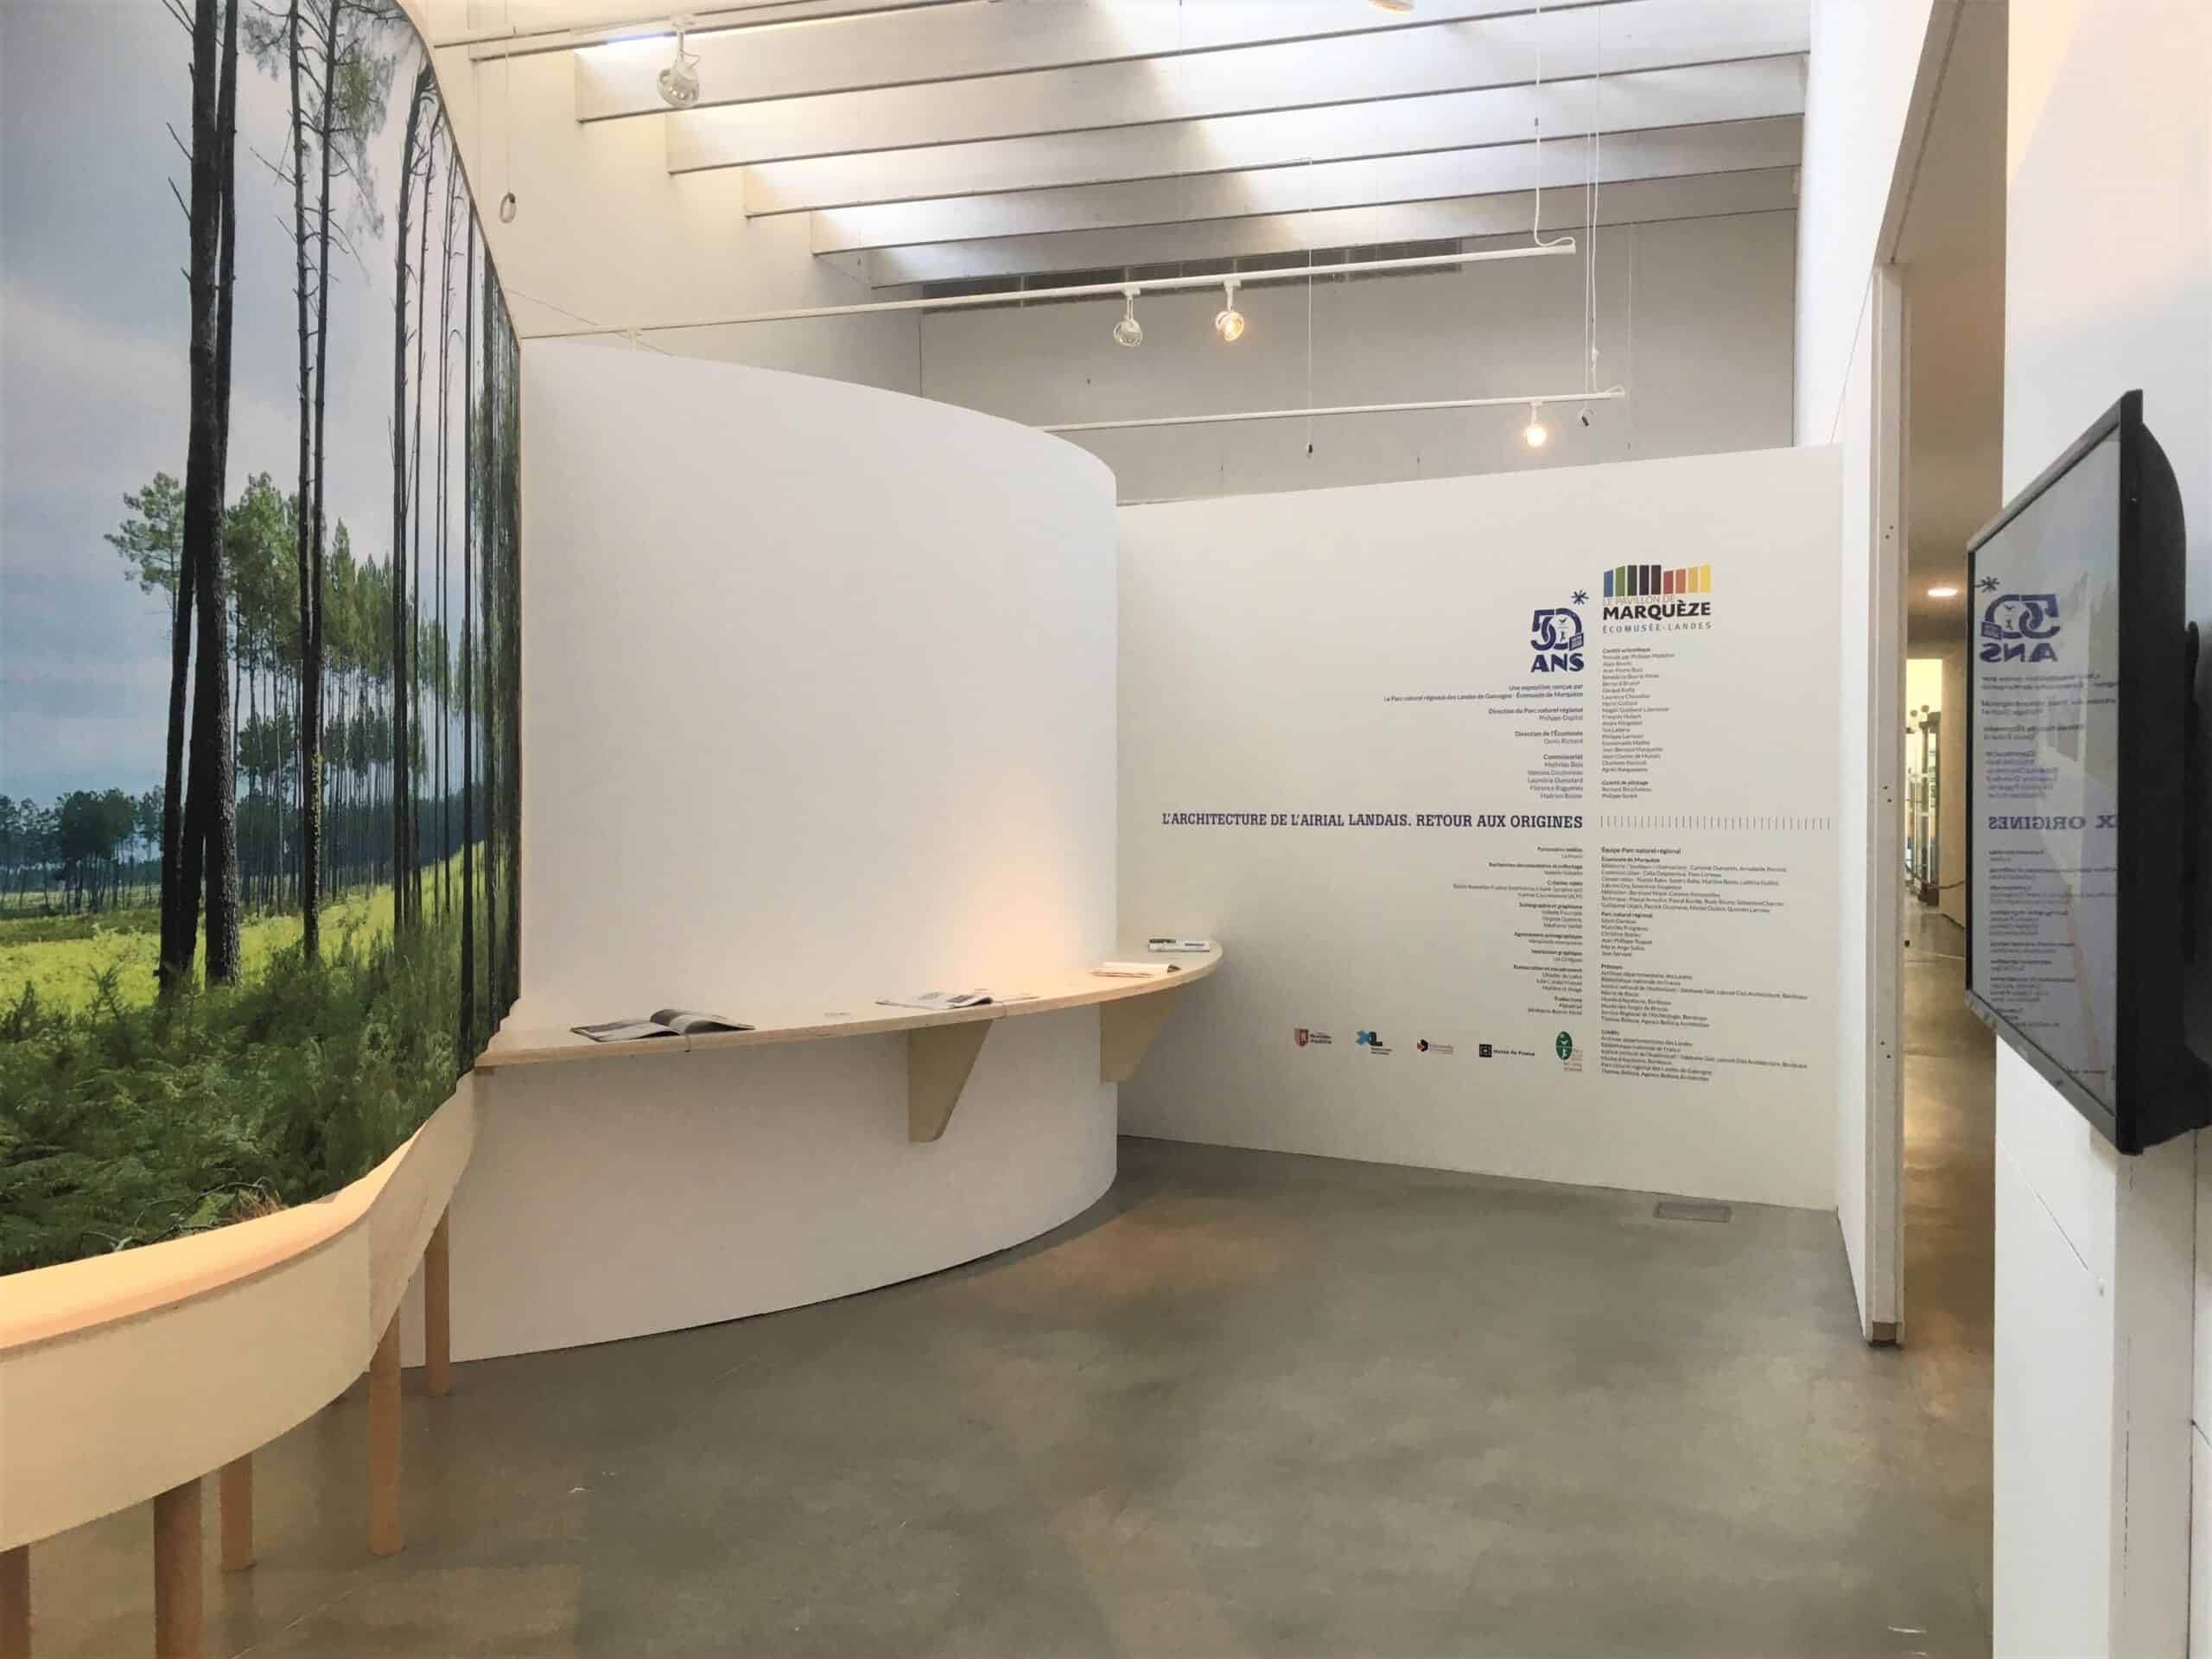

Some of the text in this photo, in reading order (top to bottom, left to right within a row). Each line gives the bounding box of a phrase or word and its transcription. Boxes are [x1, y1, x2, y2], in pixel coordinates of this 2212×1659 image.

[1603, 601, 1712, 621] MARQUÈZE
[1530, 653, 1585, 672] ANS
[1162, 812, 1583, 830] L'ARCHITECTURE DE L'AIRIAL LANDAIS. RETOUR AUX ORIGINES
